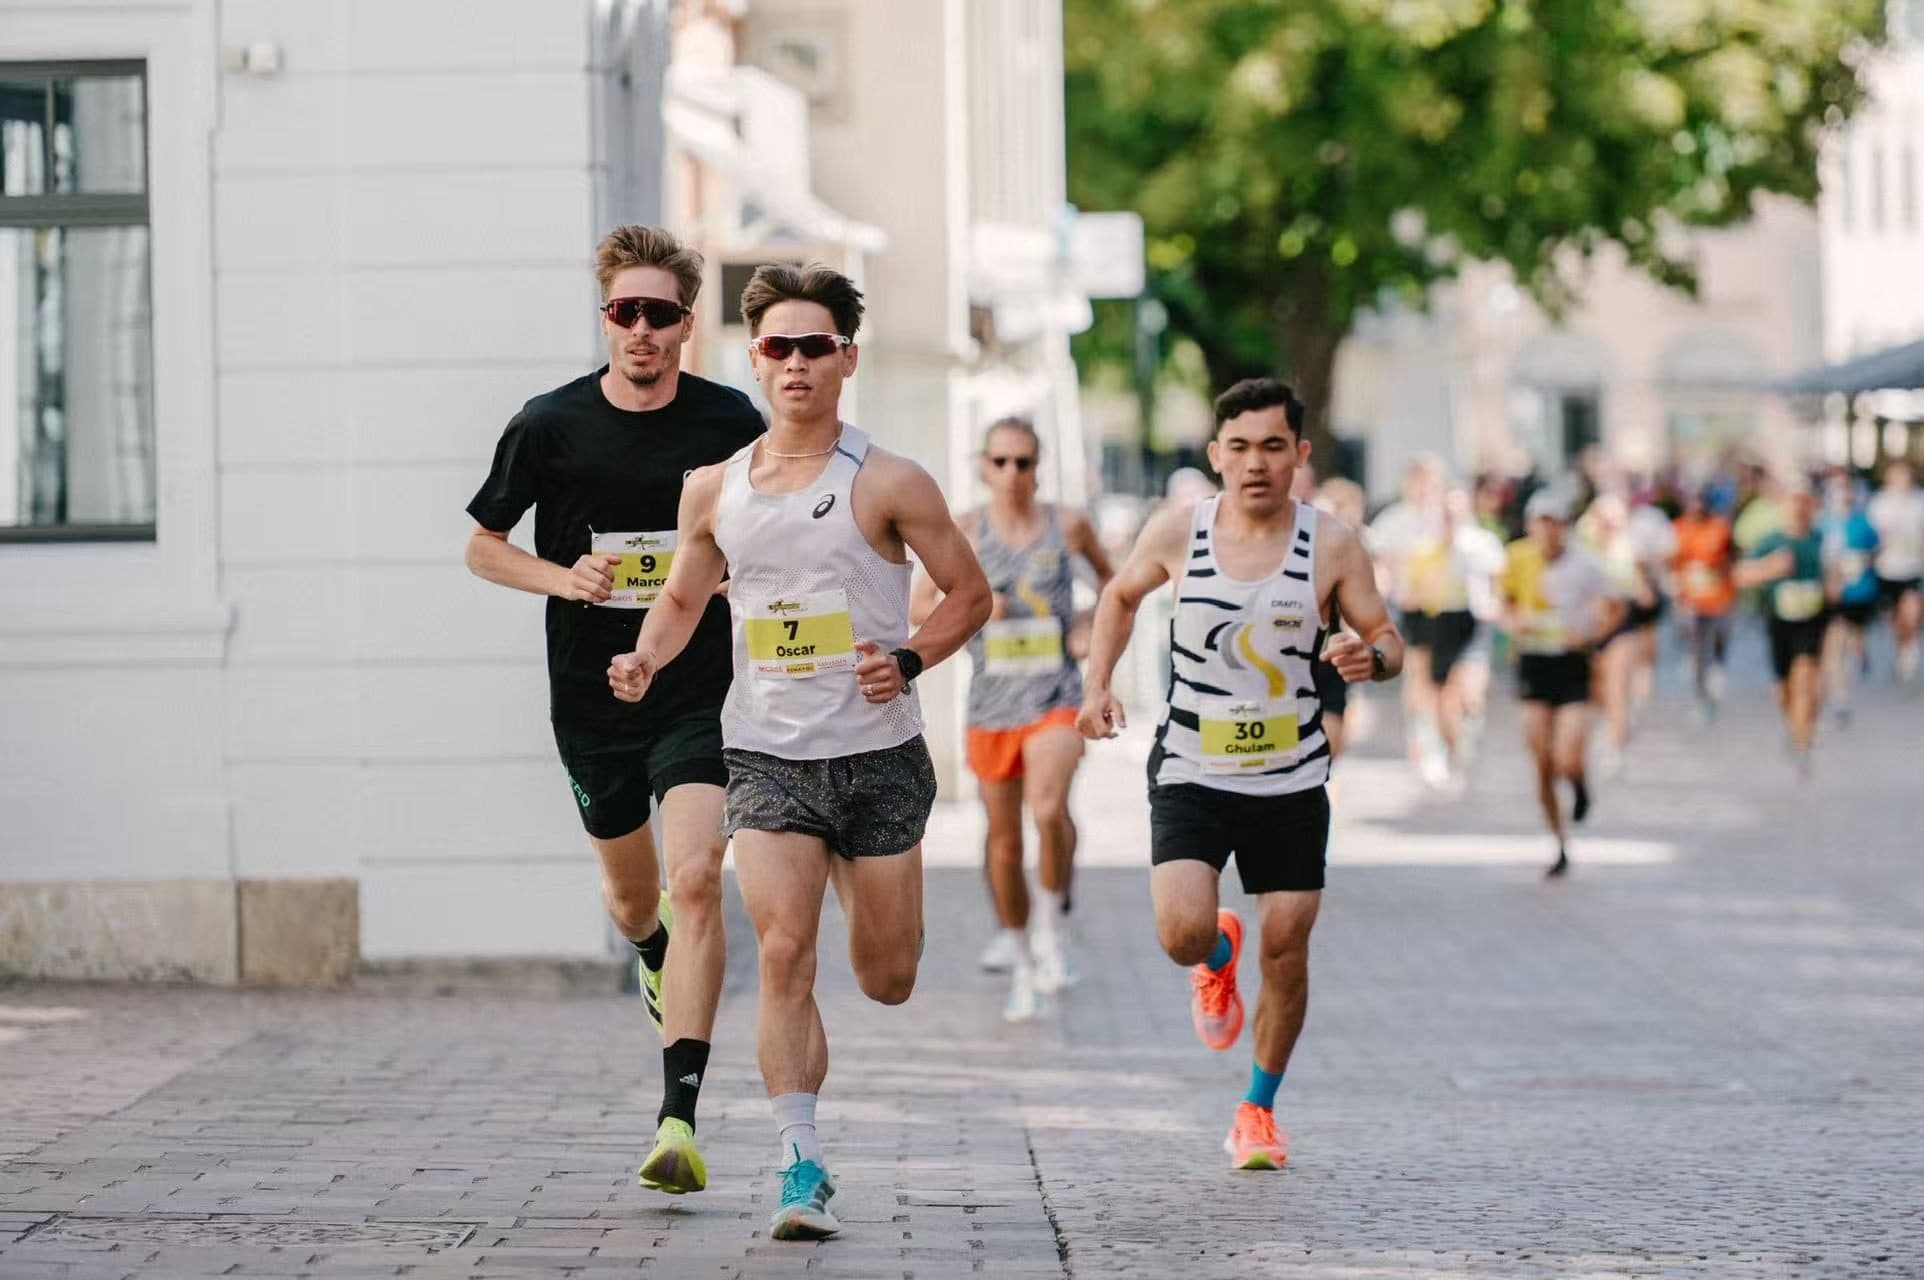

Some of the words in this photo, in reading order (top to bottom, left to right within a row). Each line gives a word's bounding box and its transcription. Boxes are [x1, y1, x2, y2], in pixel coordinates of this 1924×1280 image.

[640, 555, 656, 573] 9
[783, 620, 799, 640] 7
[776, 645, 816, 657] Oscar
[1235, 721, 1265, 740] 30
[1225, 743, 1276, 753] Ghulam
